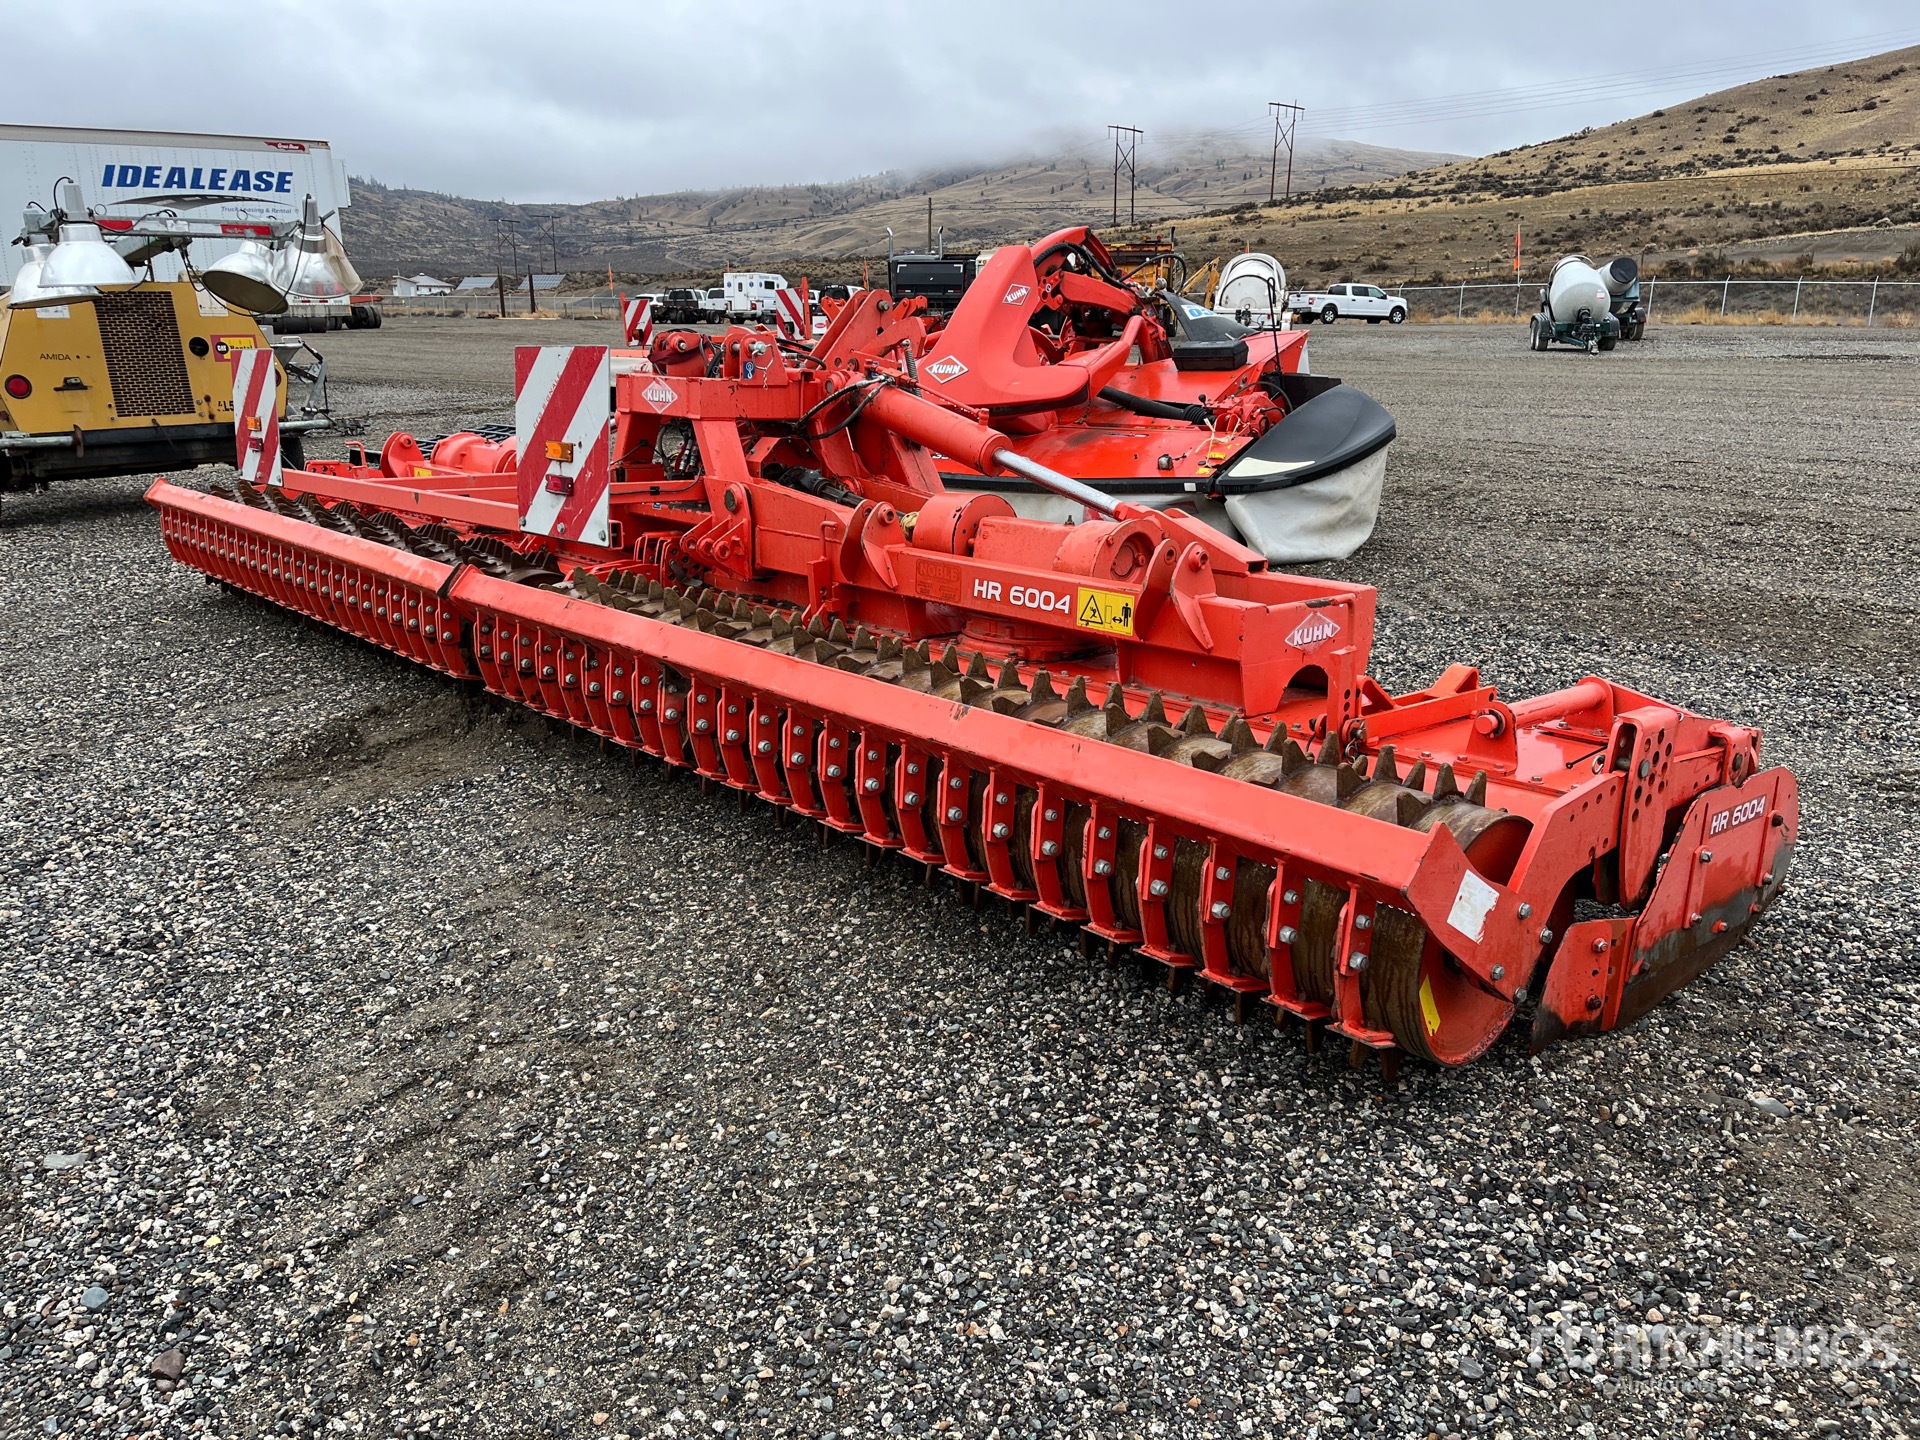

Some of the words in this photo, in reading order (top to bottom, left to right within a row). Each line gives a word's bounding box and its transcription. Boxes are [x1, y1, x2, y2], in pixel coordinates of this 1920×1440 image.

[101, 164, 294, 193] IDEALEASE
[1007, 287, 1027, 303] KUHN
[40, 353, 71, 361] AMIDA
[931, 364, 961, 375] KUHN
[647, 389, 673, 402] KUHN
[918, 562, 960, 582] NOBLE
[973, 578, 1002, 602] HR
[1009, 585, 1071, 614] 6004
[1293, 623, 1334, 646] KUHN
[1710, 811, 1729, 835] HR
[1731, 795, 1766, 826] 6004
